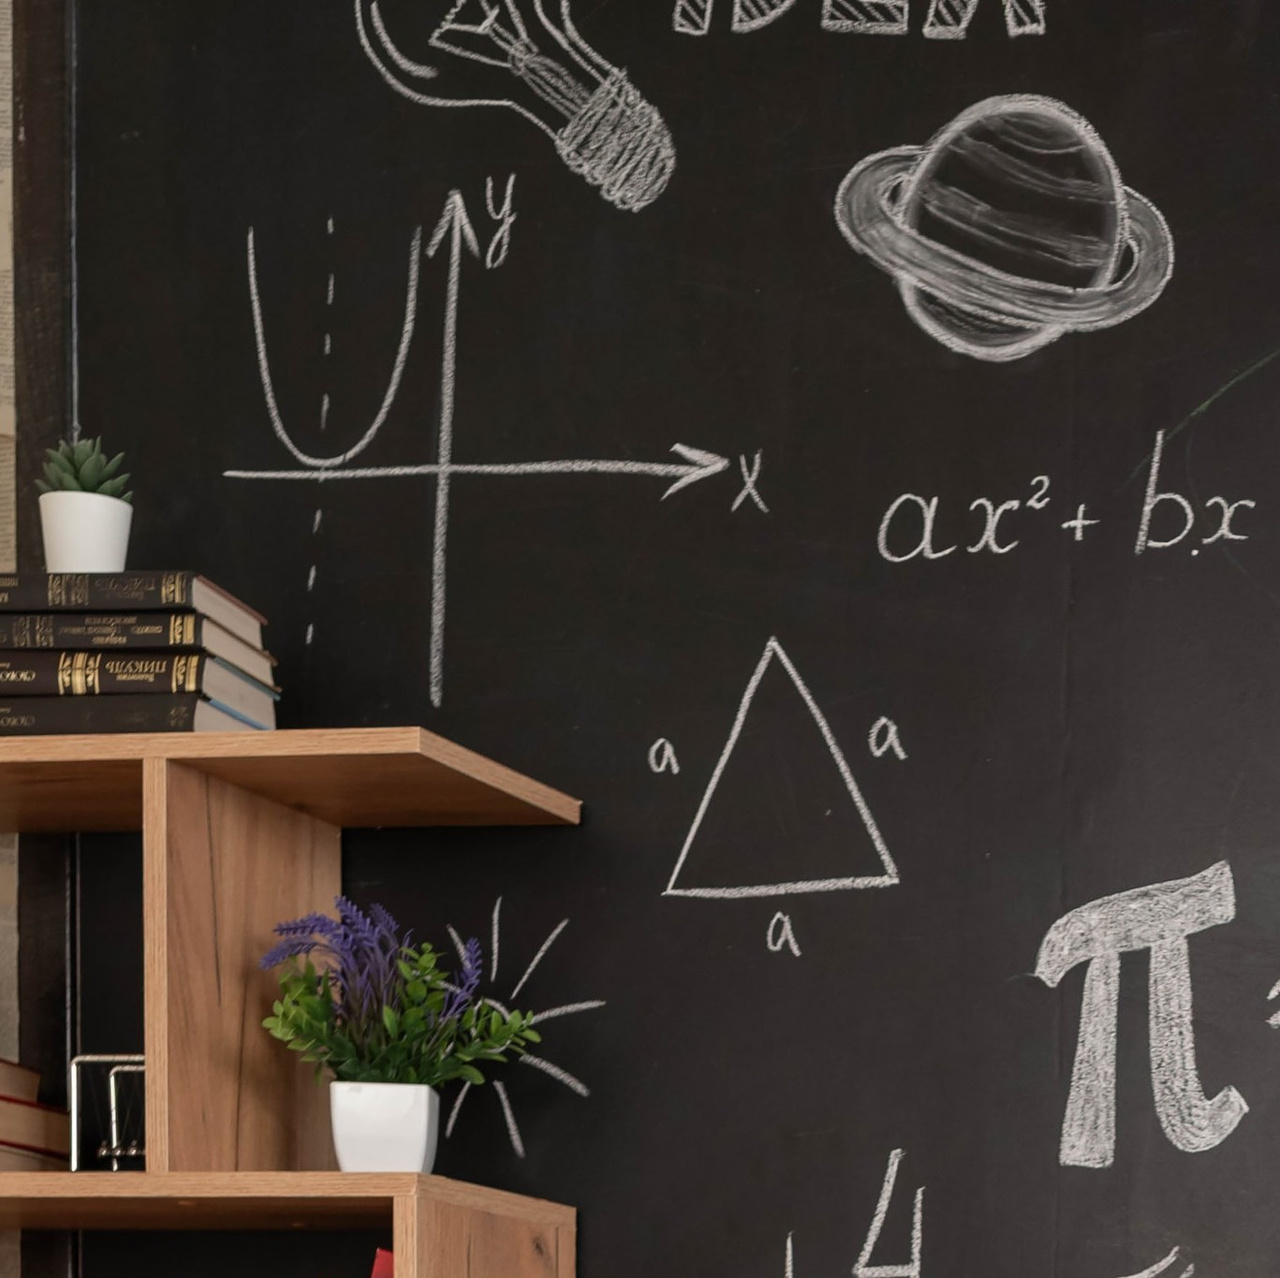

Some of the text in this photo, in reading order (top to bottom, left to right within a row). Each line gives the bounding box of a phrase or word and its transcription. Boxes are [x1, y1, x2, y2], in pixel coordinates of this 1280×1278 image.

[486, 173, 517, 269] y
[105, 660, 168, 675] ПИКУЛЬ
[648, 738, 681, 775] a
[868, 716, 909, 761] a
[766, 911, 802, 958] a
[1034, 859, 1250, 1169] π
